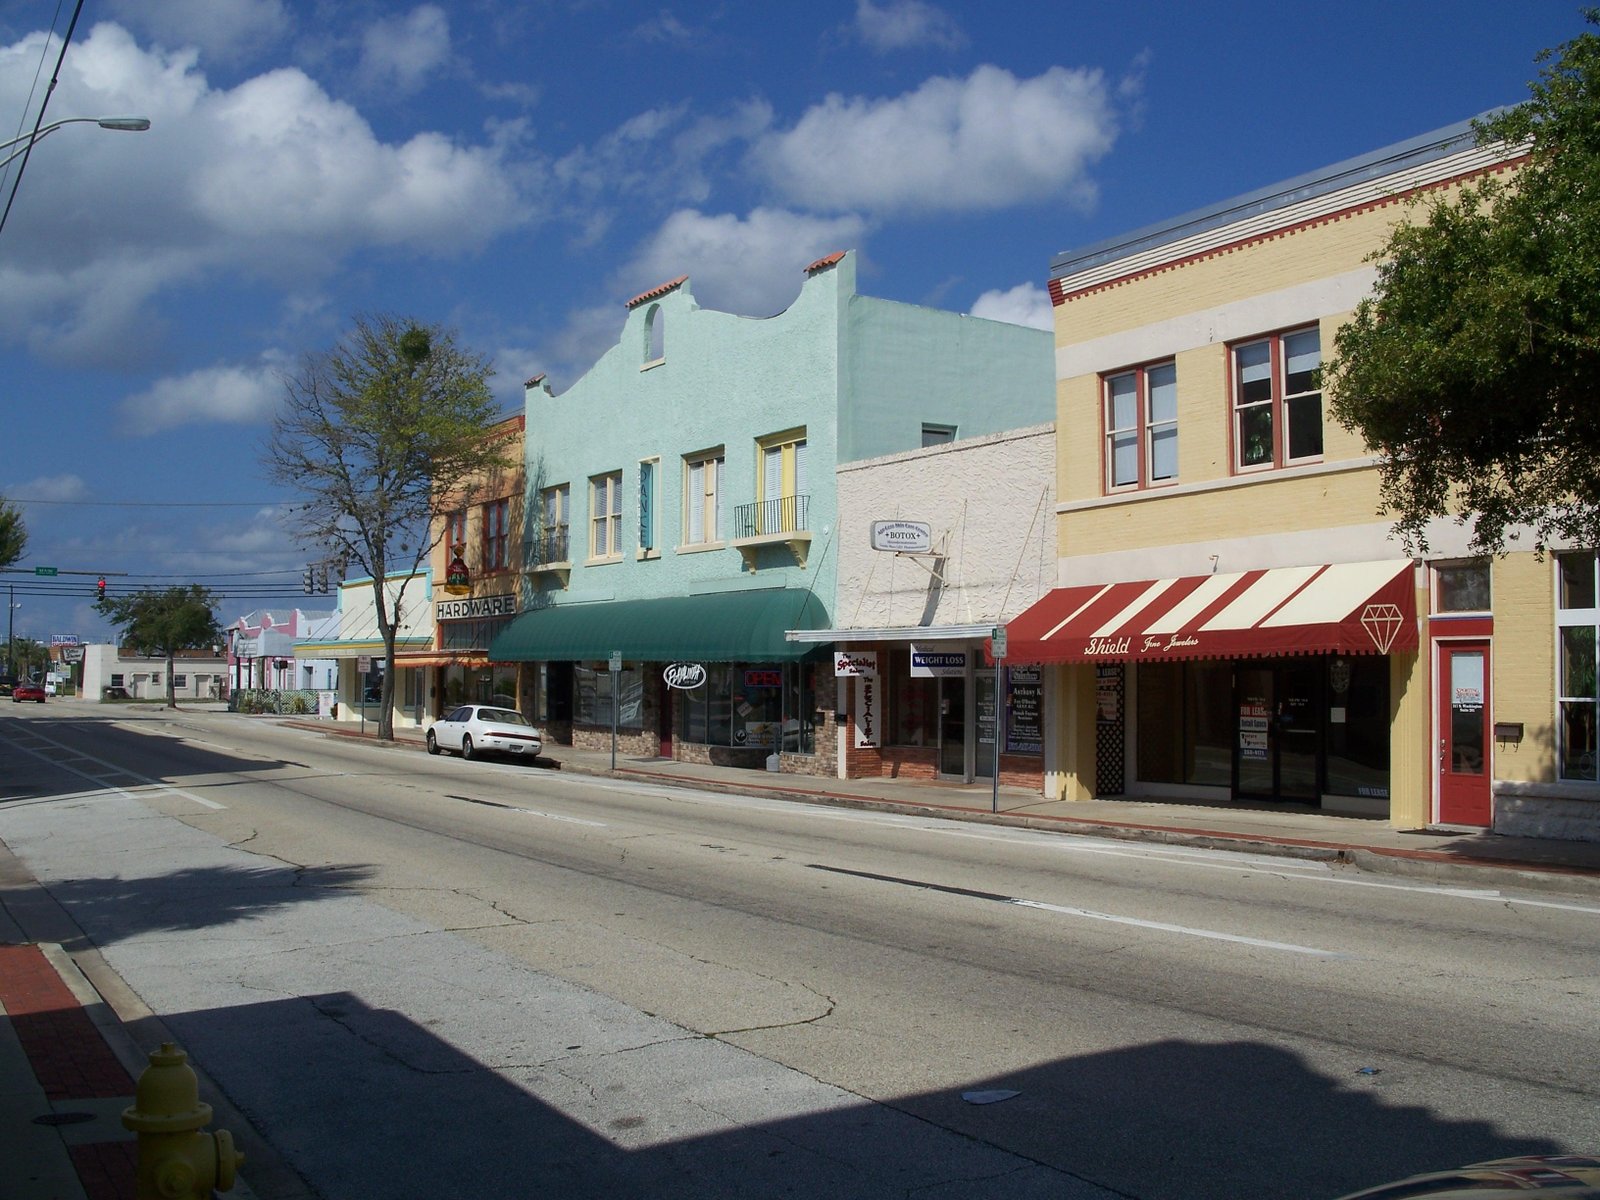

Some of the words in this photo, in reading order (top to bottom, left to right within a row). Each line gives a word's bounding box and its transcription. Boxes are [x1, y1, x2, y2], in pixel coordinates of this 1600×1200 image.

[890, 531, 916, 540] BOTOX
[437, 597, 514, 618] HARDWARE
[52, 635, 77, 643] BALDWIN
[1084, 637, 1131, 655] Shield
[837, 657, 876, 671] Specialist
[914, 656, 944, 665] WEIGHT
[945, 656, 964, 665] LOSS
[746, 671, 782, 686] OPEN
[1240, 706, 1251, 716] FOR
[1370, 788, 1389, 798] LEASE
